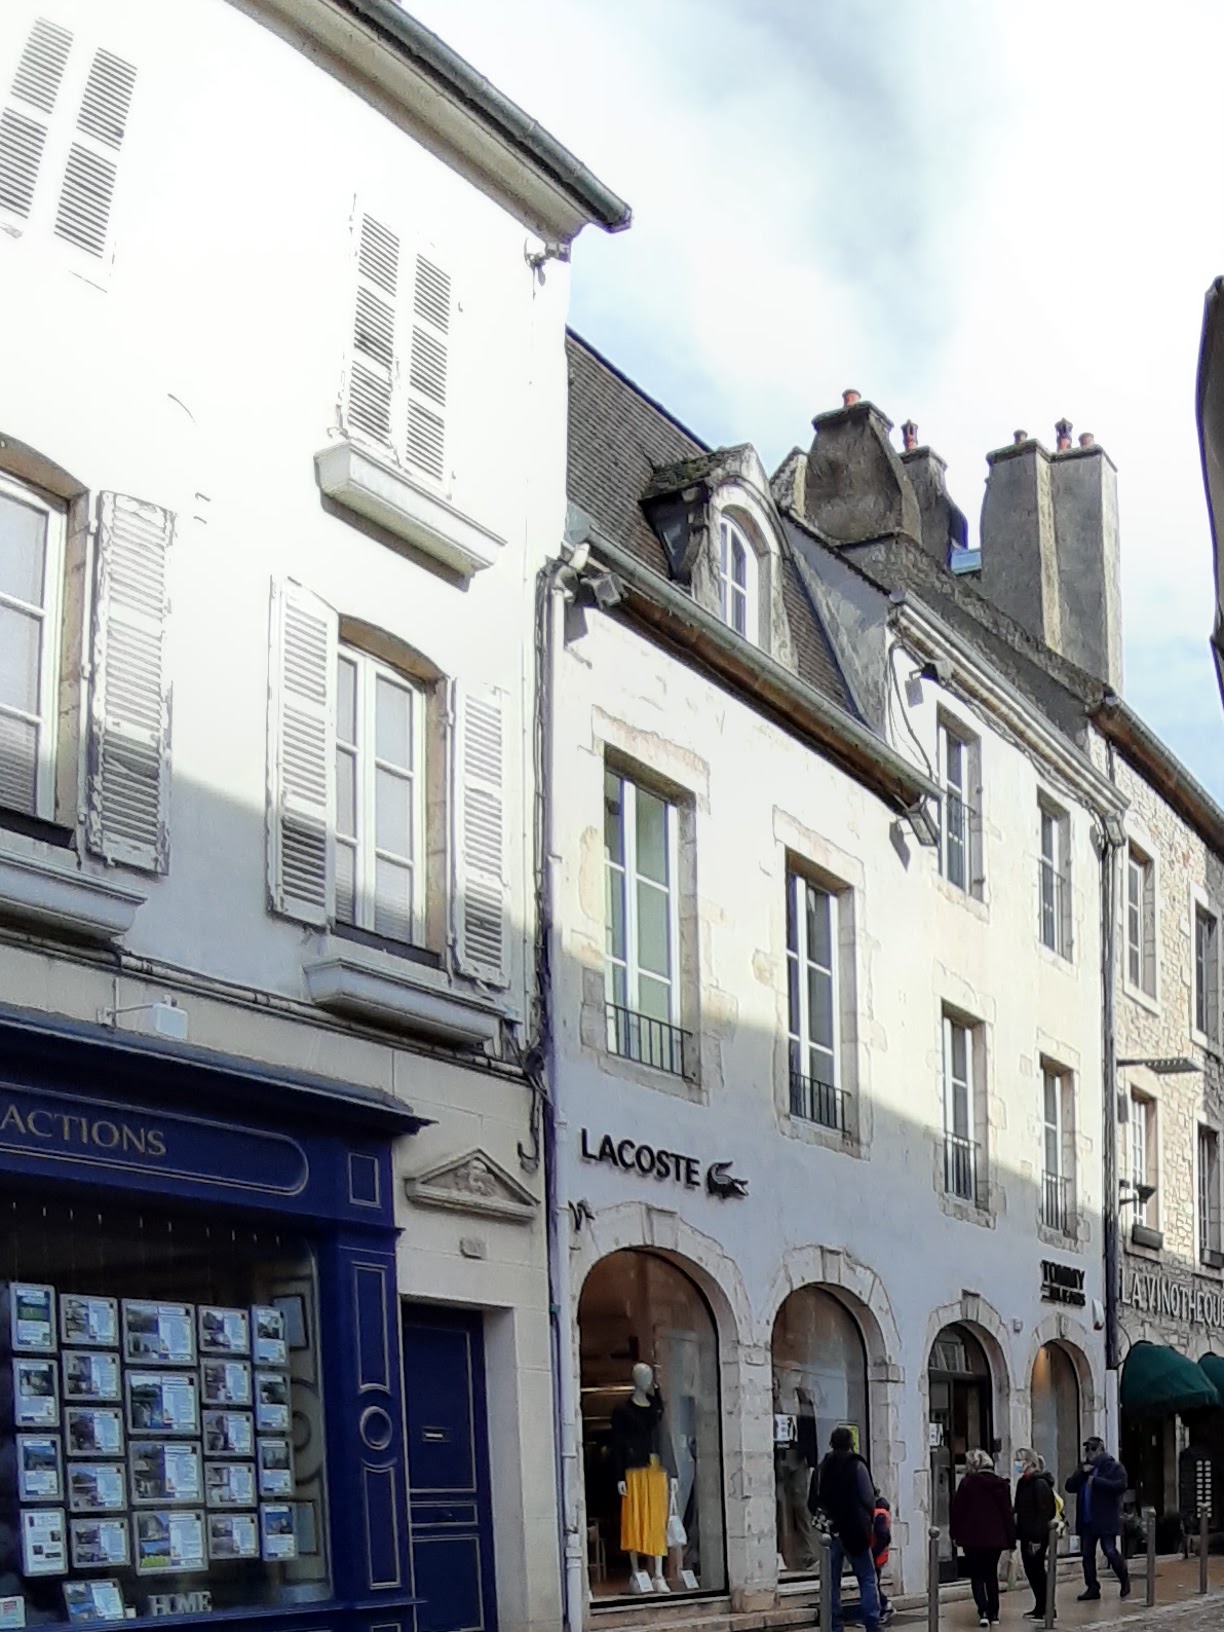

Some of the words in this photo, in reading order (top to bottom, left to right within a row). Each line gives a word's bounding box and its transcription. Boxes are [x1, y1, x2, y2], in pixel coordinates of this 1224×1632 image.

[580, 1127, 701, 1188] LACOSTE
[1119, 1266, 1142, 1309] LA
[147, 1591, 212, 1616] HOME
